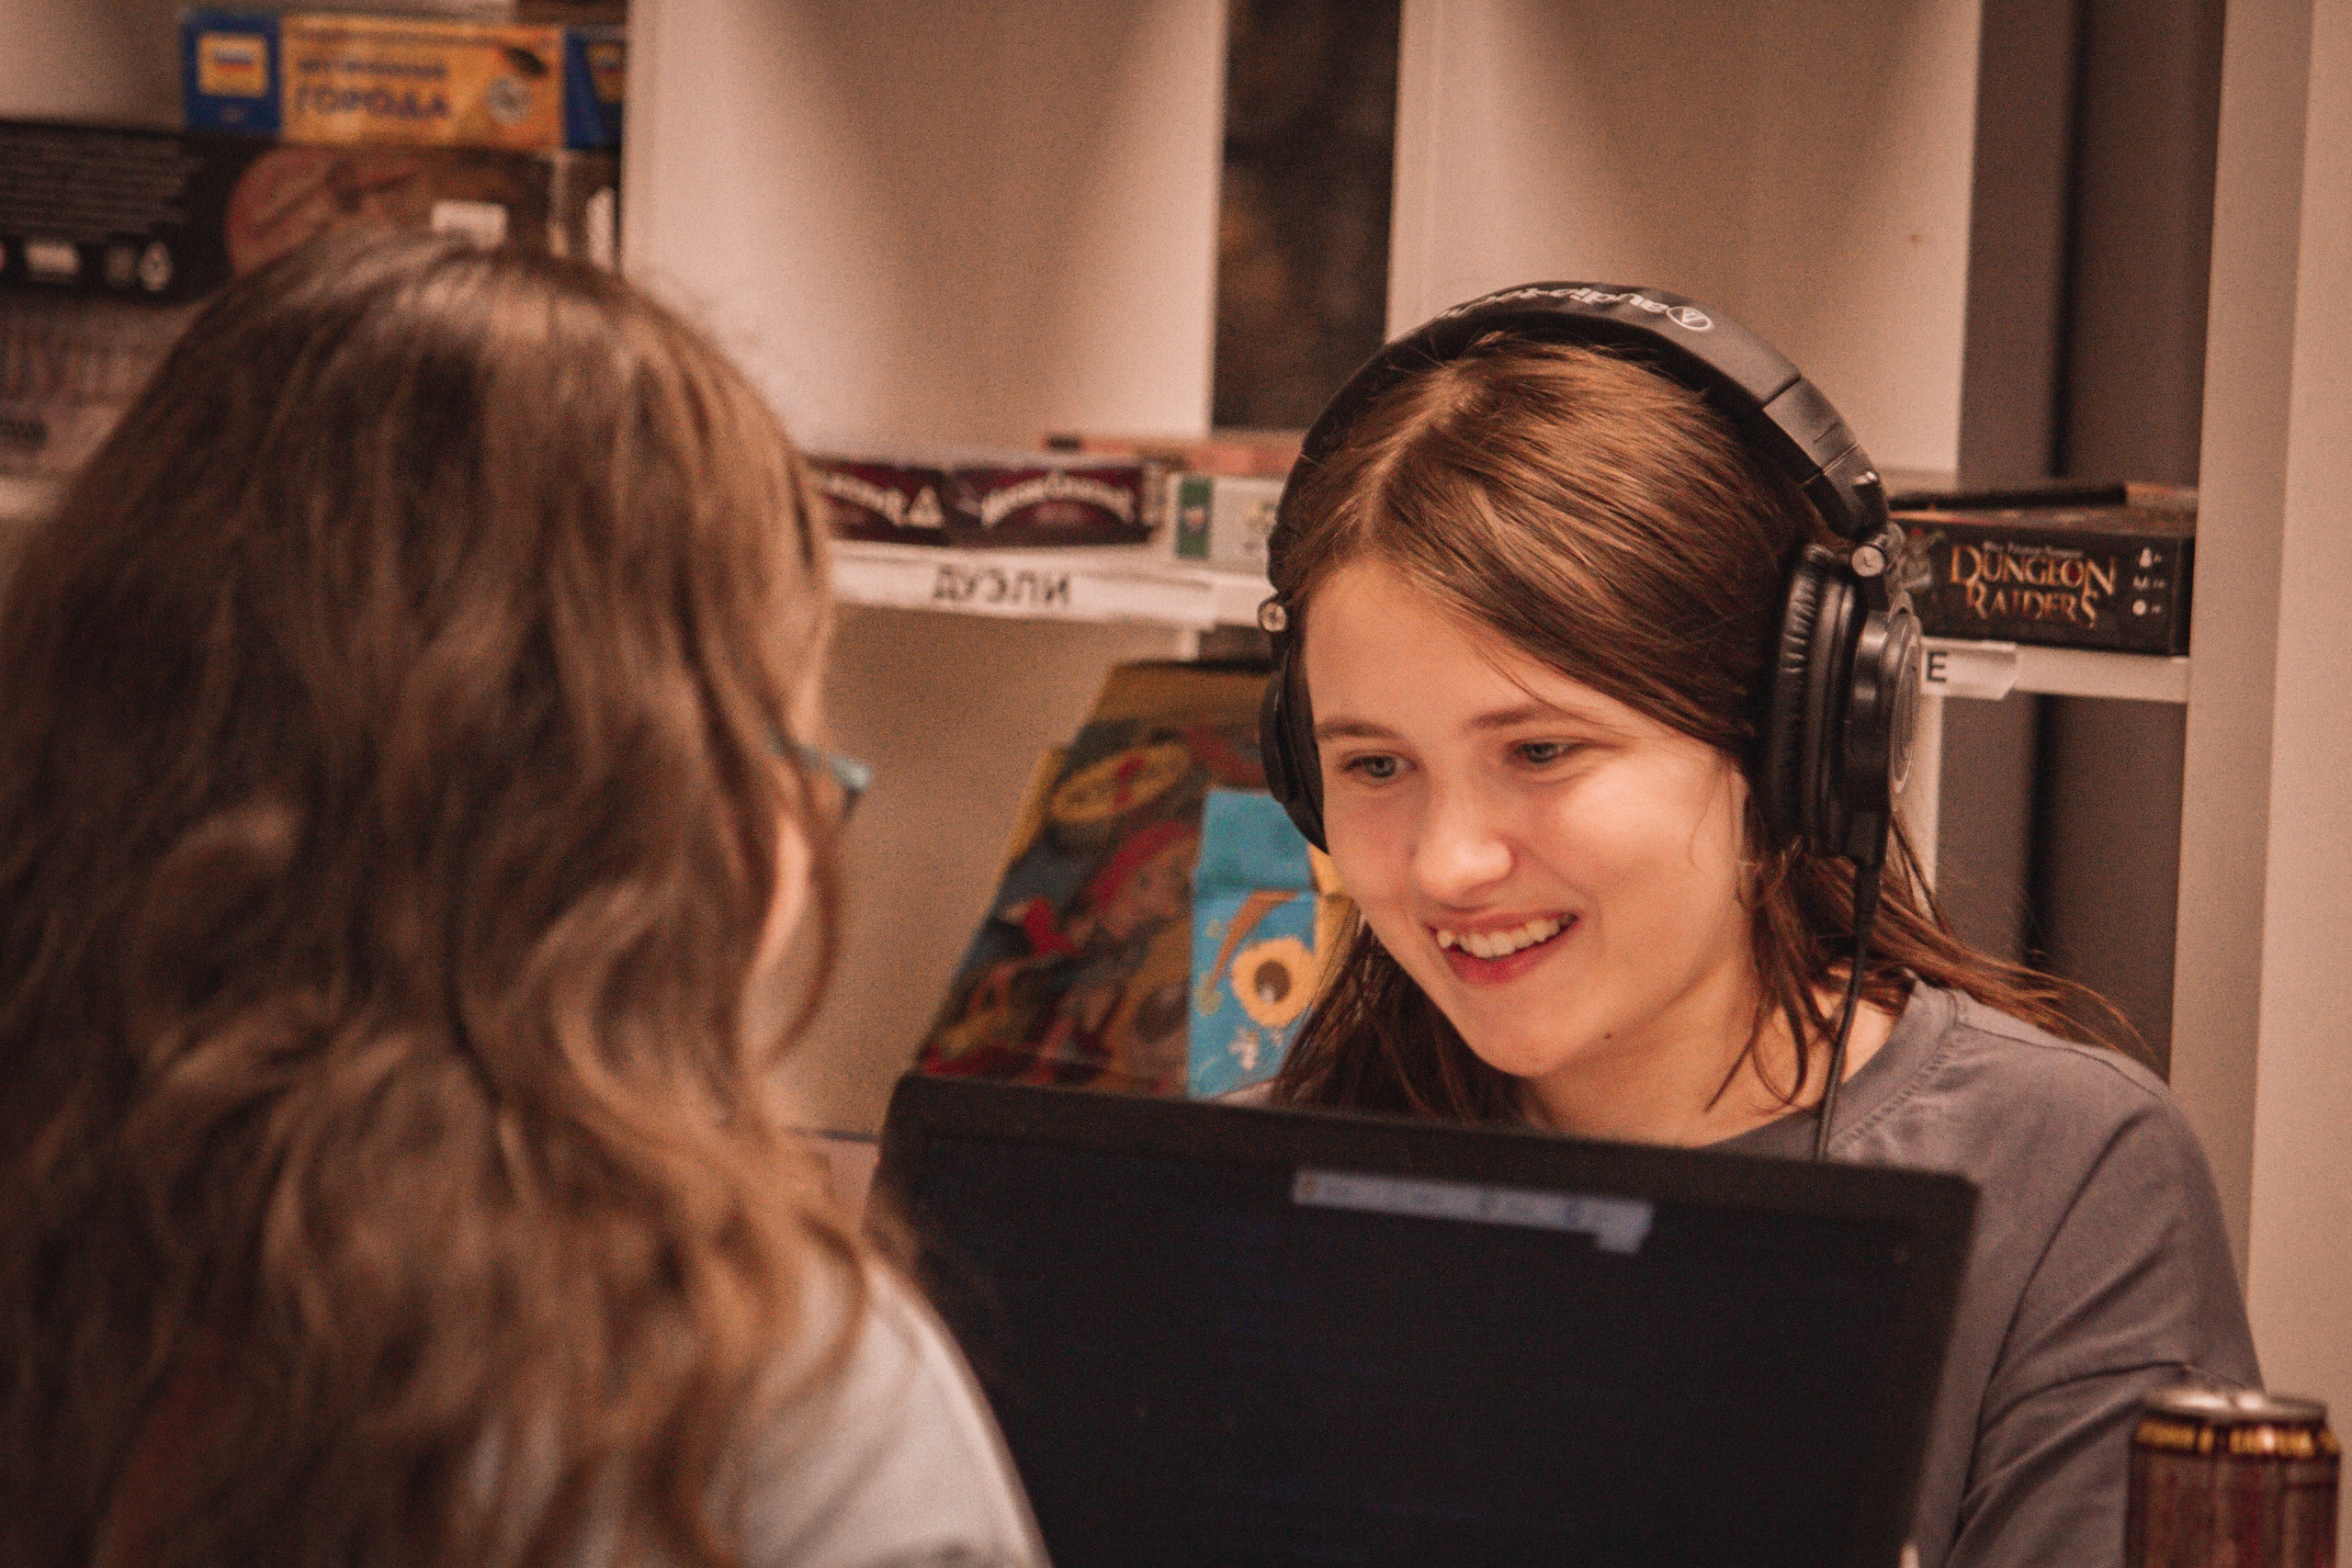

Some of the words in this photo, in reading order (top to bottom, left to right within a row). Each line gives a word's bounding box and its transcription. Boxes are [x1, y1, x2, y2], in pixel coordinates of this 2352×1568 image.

[295, 82, 448, 120] ГОРОДА
[933, 565, 1070, 604] ДУЭЛИ
[1950, 545, 2118, 595] DUNGEON
[1965, 582, 2099, 630] RAIDERS
